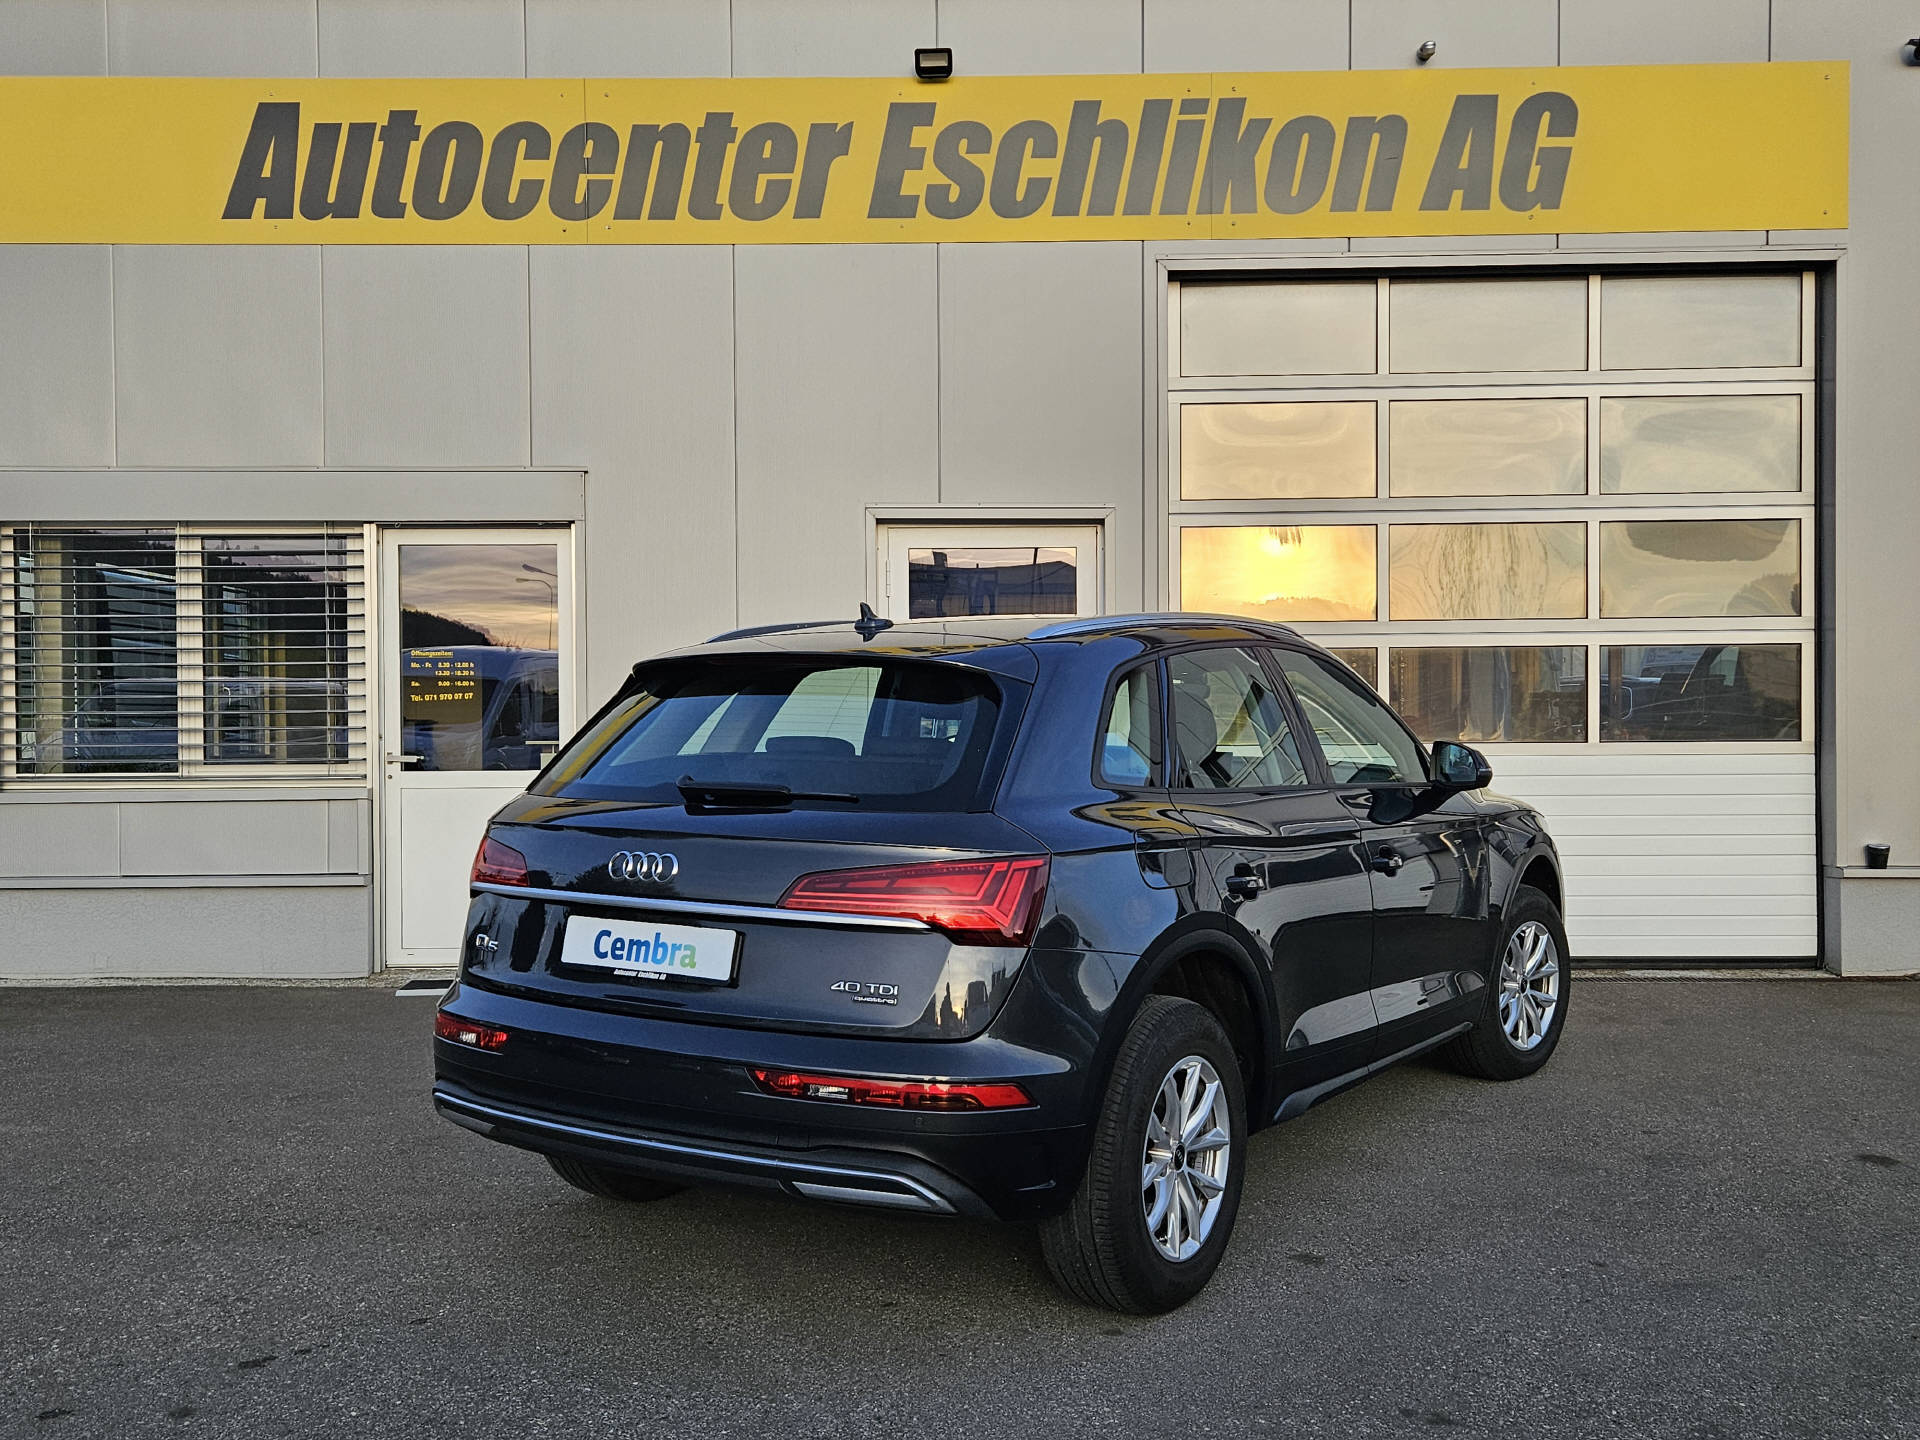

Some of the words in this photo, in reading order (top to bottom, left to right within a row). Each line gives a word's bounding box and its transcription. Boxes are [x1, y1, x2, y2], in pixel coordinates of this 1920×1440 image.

[222, 102, 854, 221] Autocenter
[868, 97, 1408, 220] Eschlikon
[1418, 92, 1580, 213] AG
[439, 693, 452, 701] 970
[464, 692, 473, 700] 07
[593, 929, 697, 969] Cembra
[830, 981, 861, 993] 40
[865, 983, 899, 996] TDI
